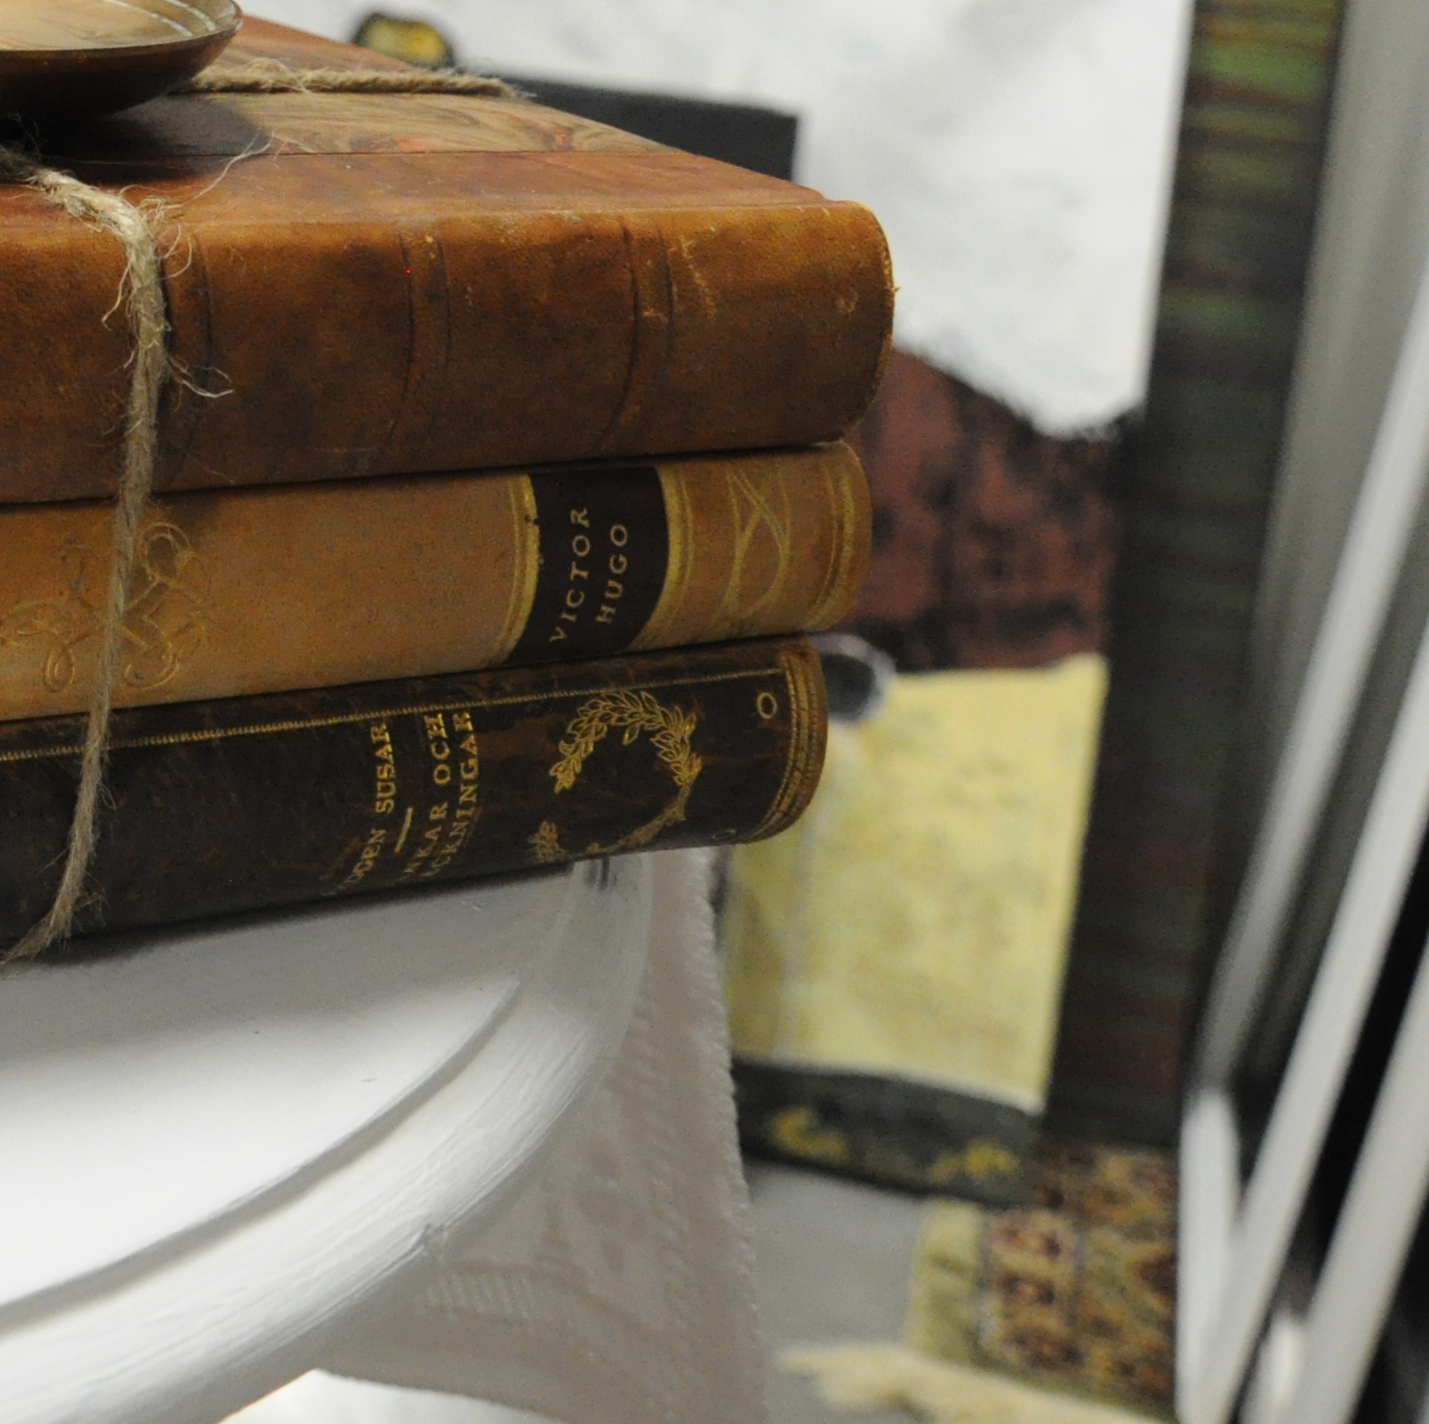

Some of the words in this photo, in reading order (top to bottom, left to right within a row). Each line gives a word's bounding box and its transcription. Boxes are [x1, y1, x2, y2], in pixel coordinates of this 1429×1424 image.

[549, 508, 590, 642] VICTOR
[596, 524, 629, 624] HUGO
[370, 722, 397, 814] SUSAR
[420, 712, 480, 877] CKNINGAR
[423, 713, 451, 786] OCH
